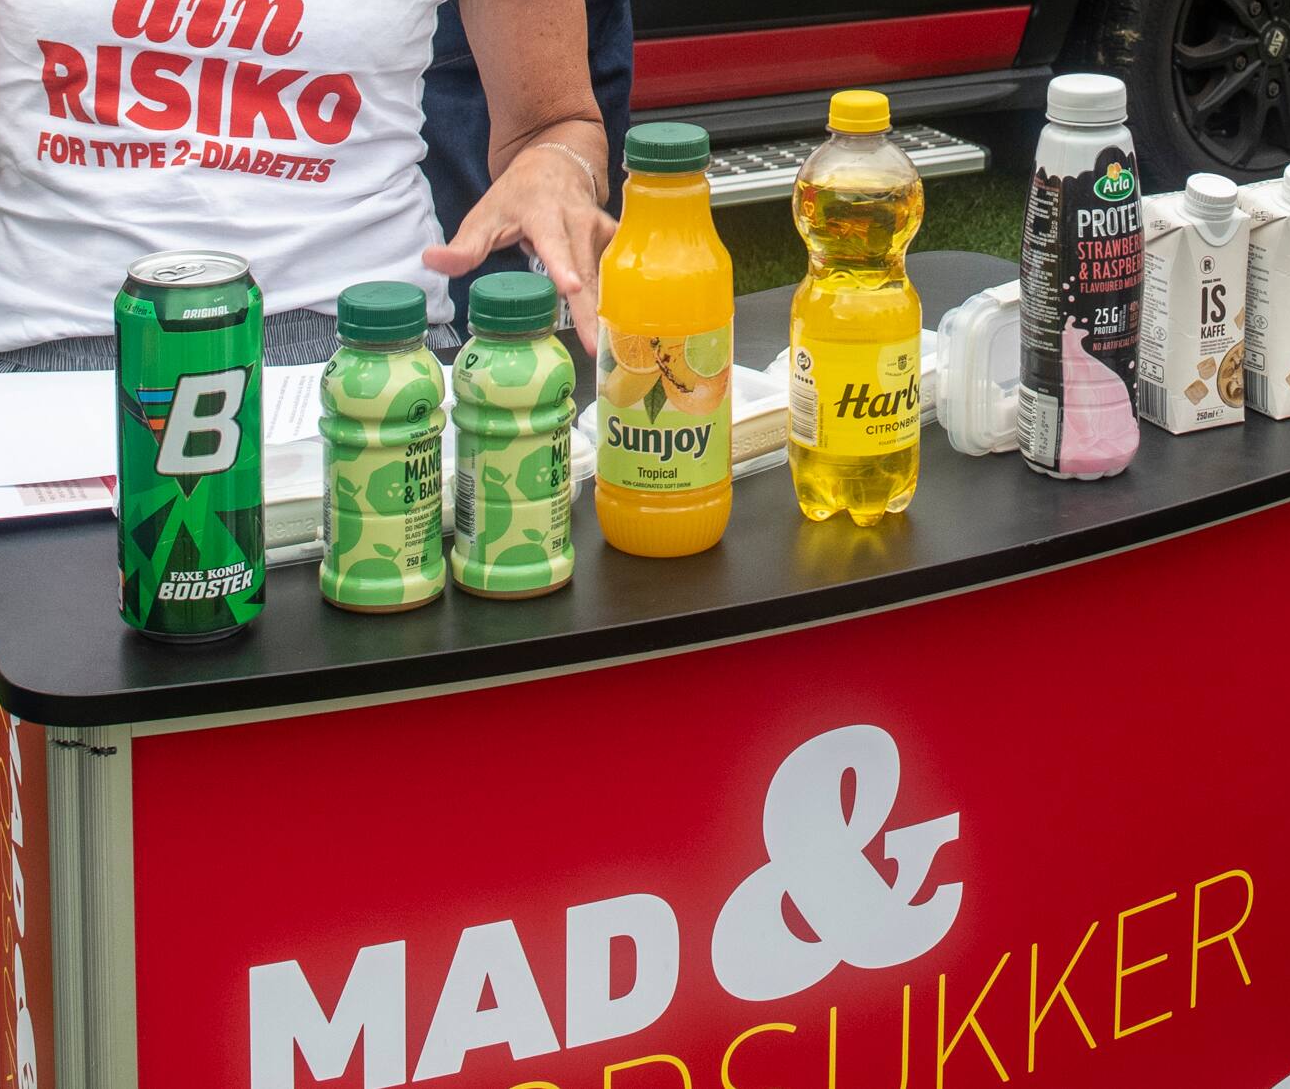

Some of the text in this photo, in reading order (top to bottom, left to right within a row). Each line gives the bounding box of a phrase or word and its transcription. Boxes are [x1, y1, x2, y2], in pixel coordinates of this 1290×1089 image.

[37, 39, 362, 146] RISIKO
[37, 131, 337, 184] FOR TYPE 2-DIABETES
[1102, 177, 1130, 195] Arla
[1079, 262, 1088, 280] &
[1080, 280, 1123, 294] FLAVOURED
[182, 305, 230, 319] ORIGINAL
[1200, 284, 1226, 325] IS
[1094, 307, 1109, 325] 25
[1111, 306, 1118, 323] G
[1093, 325, 1118, 335] PROTEIN
[1200, 323, 1226, 340] KAFFE
[1092, 342, 1101, 351] NO
[834, 374, 920, 419] Harb
[155, 368, 247, 476] B
[607, 415, 712, 463] Sunjoy
[551, 469, 559, 488] &
[637, 466, 678, 482] Tropical
[621, 479, 692, 490] NON-CARBONATED SOFT DRINK
[403, 485, 415, 505] &
[406, 553, 428, 567] 250 ml
[170, 561, 246, 582] FAXE KONDI
[158, 568, 254, 601] BOOSTER
[249, 724, 964, 1089] MAD &
[506, 869, 1253, 1089] UKKER
